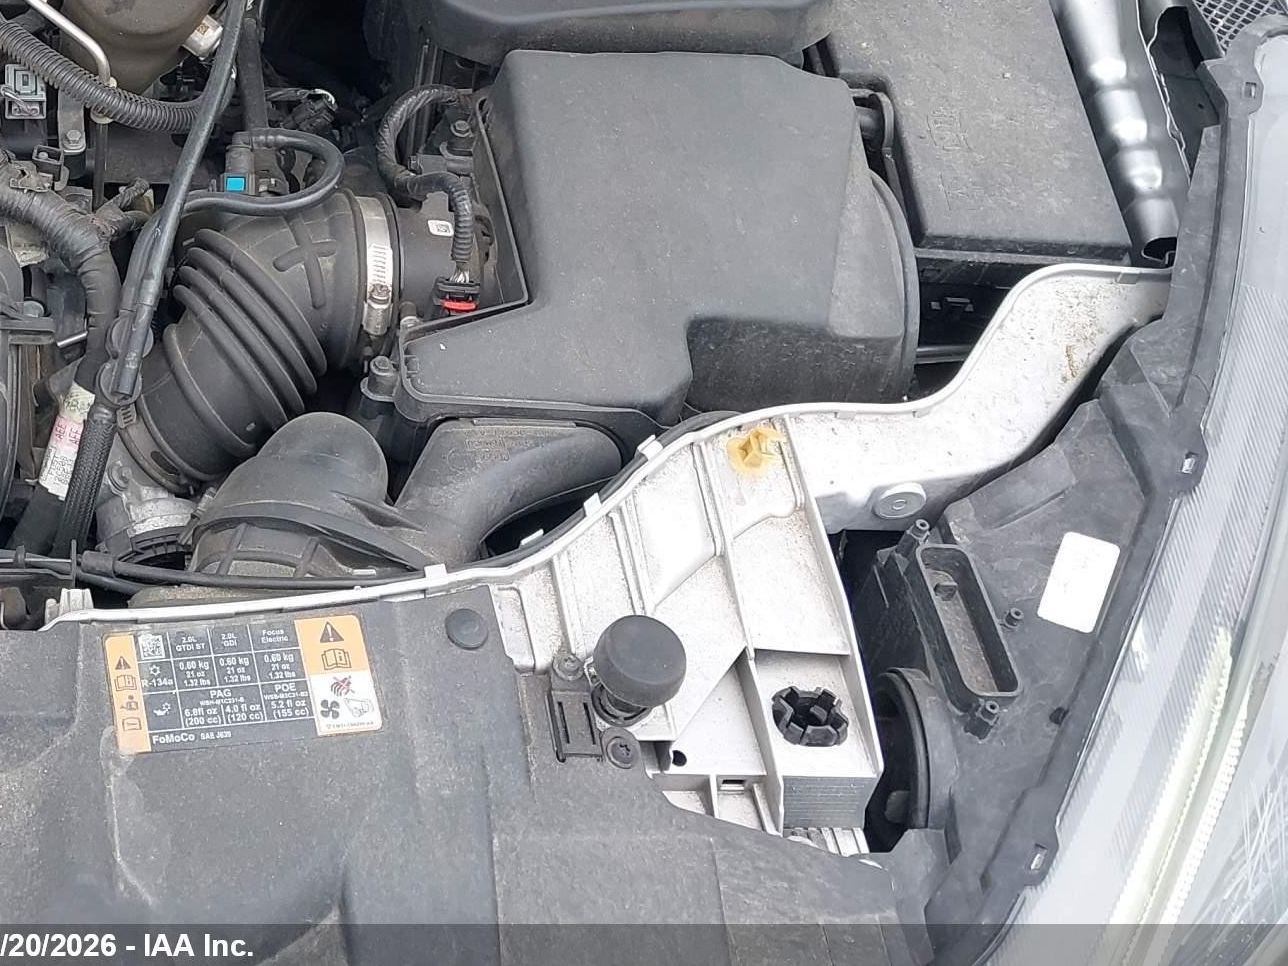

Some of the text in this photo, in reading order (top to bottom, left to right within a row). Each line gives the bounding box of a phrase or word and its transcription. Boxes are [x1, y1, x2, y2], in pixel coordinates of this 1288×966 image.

[176, 644, 194, 652] GTDI
[220, 657, 250, 667] 0.60 kg
[264, 653, 294, 663] 0.60 kg
[179, 661, 209, 671] 0.60 kg
[142, 679, 173, 687] R-134a
[224, 674, 251, 683] 1.32 lbs
[275, 683, 296, 692] POE
[210, 689, 232, 698] PAG
[271, 701, 284, 709] 5.2
[286, 700, 293, 708] fl
[228, 711, 264, 723] (120 cc)
[273, 708, 309, 719] (155 cc)
[185, 715, 221, 727] (200 cc)
[152, 733, 195, 744] FoMoCo
